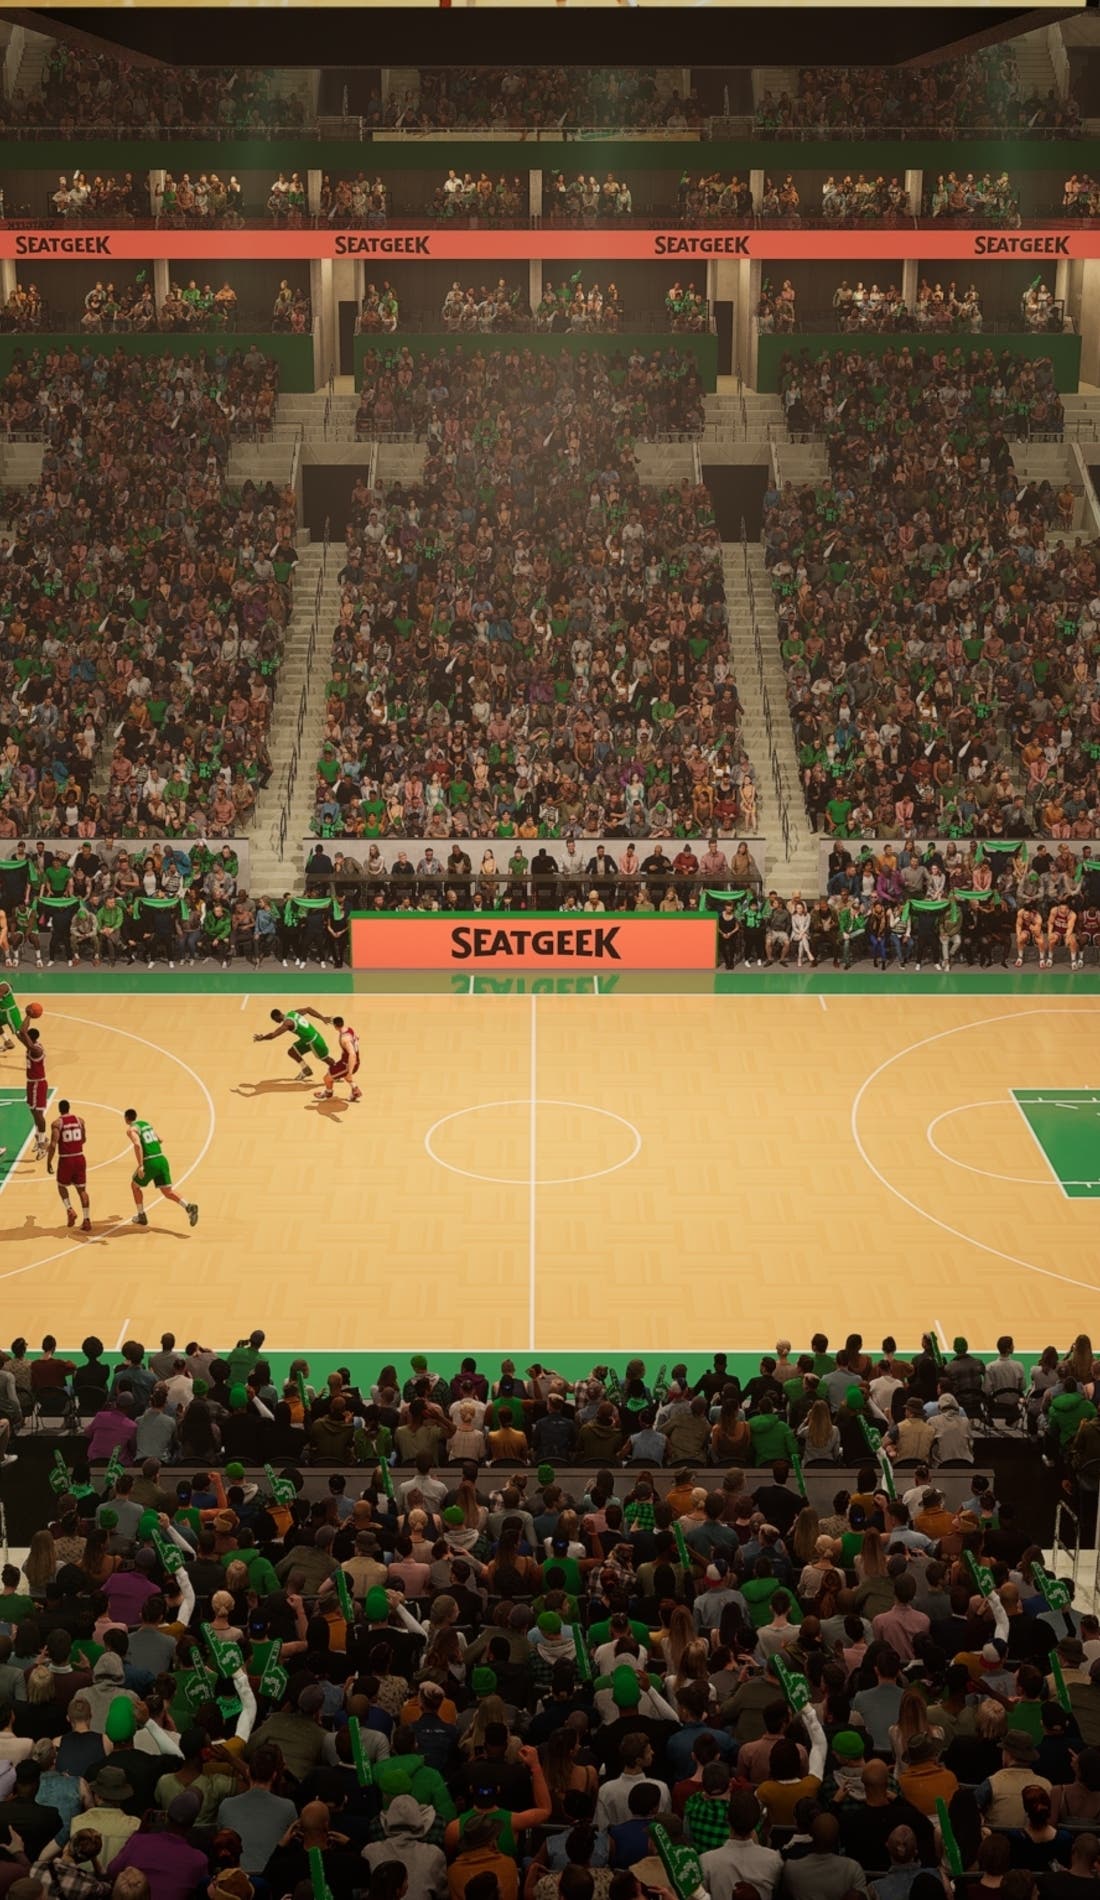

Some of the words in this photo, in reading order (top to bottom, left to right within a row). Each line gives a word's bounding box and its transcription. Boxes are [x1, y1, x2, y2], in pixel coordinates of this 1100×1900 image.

[16, 236, 111, 254] SEATGEEK
[336, 236, 430, 254] SEATGEEK
[655, 236, 749, 254] SEATGEEK
[975, 236, 1069, 254] SEATGEEK
[452, 927, 621, 959] SEATGEEK
